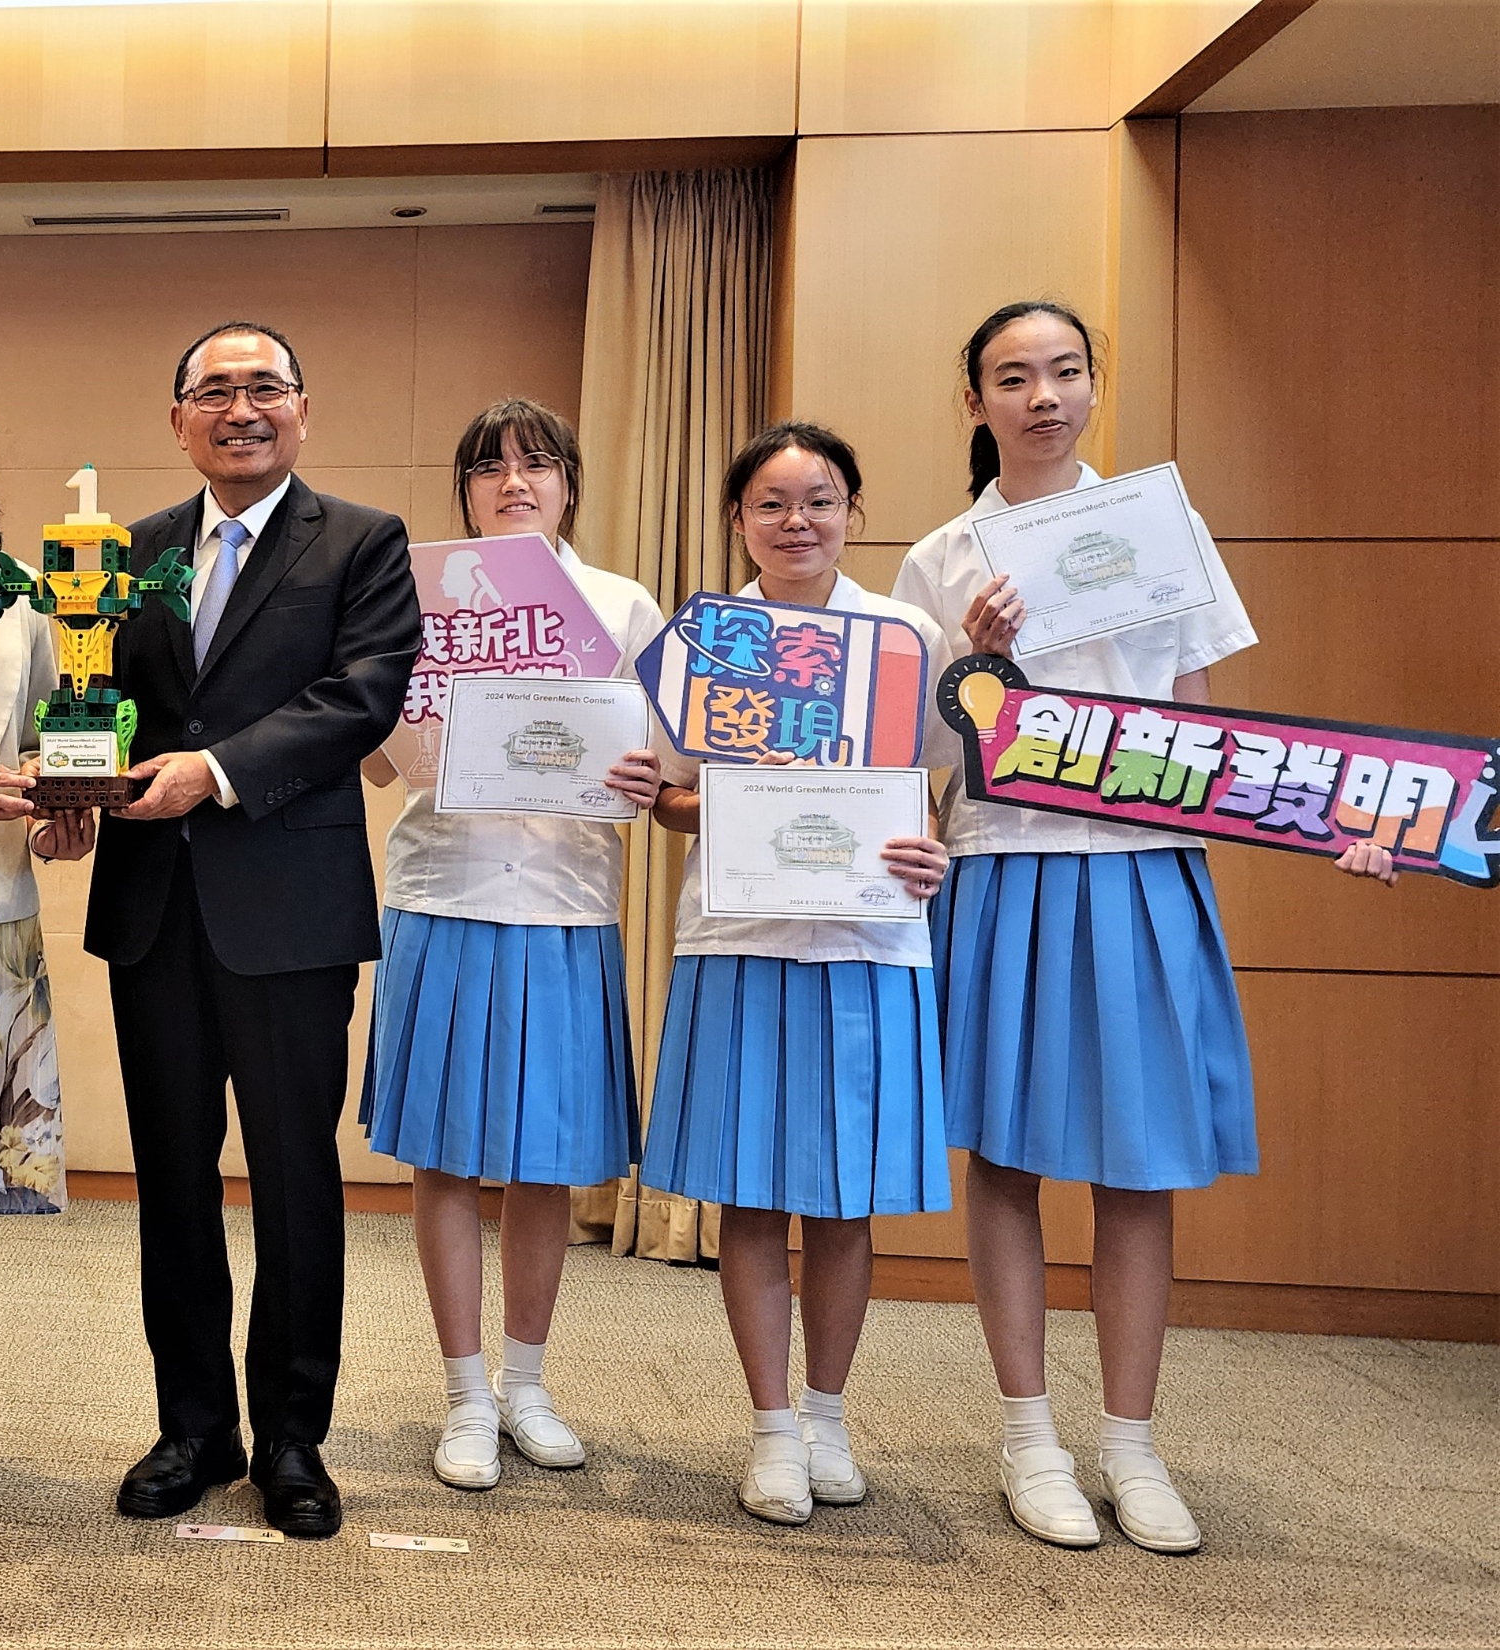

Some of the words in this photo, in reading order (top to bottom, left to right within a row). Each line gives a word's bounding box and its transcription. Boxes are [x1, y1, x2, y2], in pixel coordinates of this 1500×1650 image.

[1013, 521, 1034, 533] 2024
[1035, 513, 1060, 526] World
[1061, 500, 1109, 519] GreenMech
[1110, 491, 1143, 506] Contest
[690, 605, 843, 688] 探索
[485, 692, 504, 700] 2024
[506, 692, 531, 700] World
[532, 693, 581, 703] GreenMech
[583, 696, 616, 705] Contest
[709, 685, 848, 767] 發現
[743, 784, 764, 793] 2024
[766, 785, 793, 794] World
[795, 785, 847, 795] GreenMech
[849, 786, 885, 796] Contest
[991, 694, 1457, 855] 創新發明
